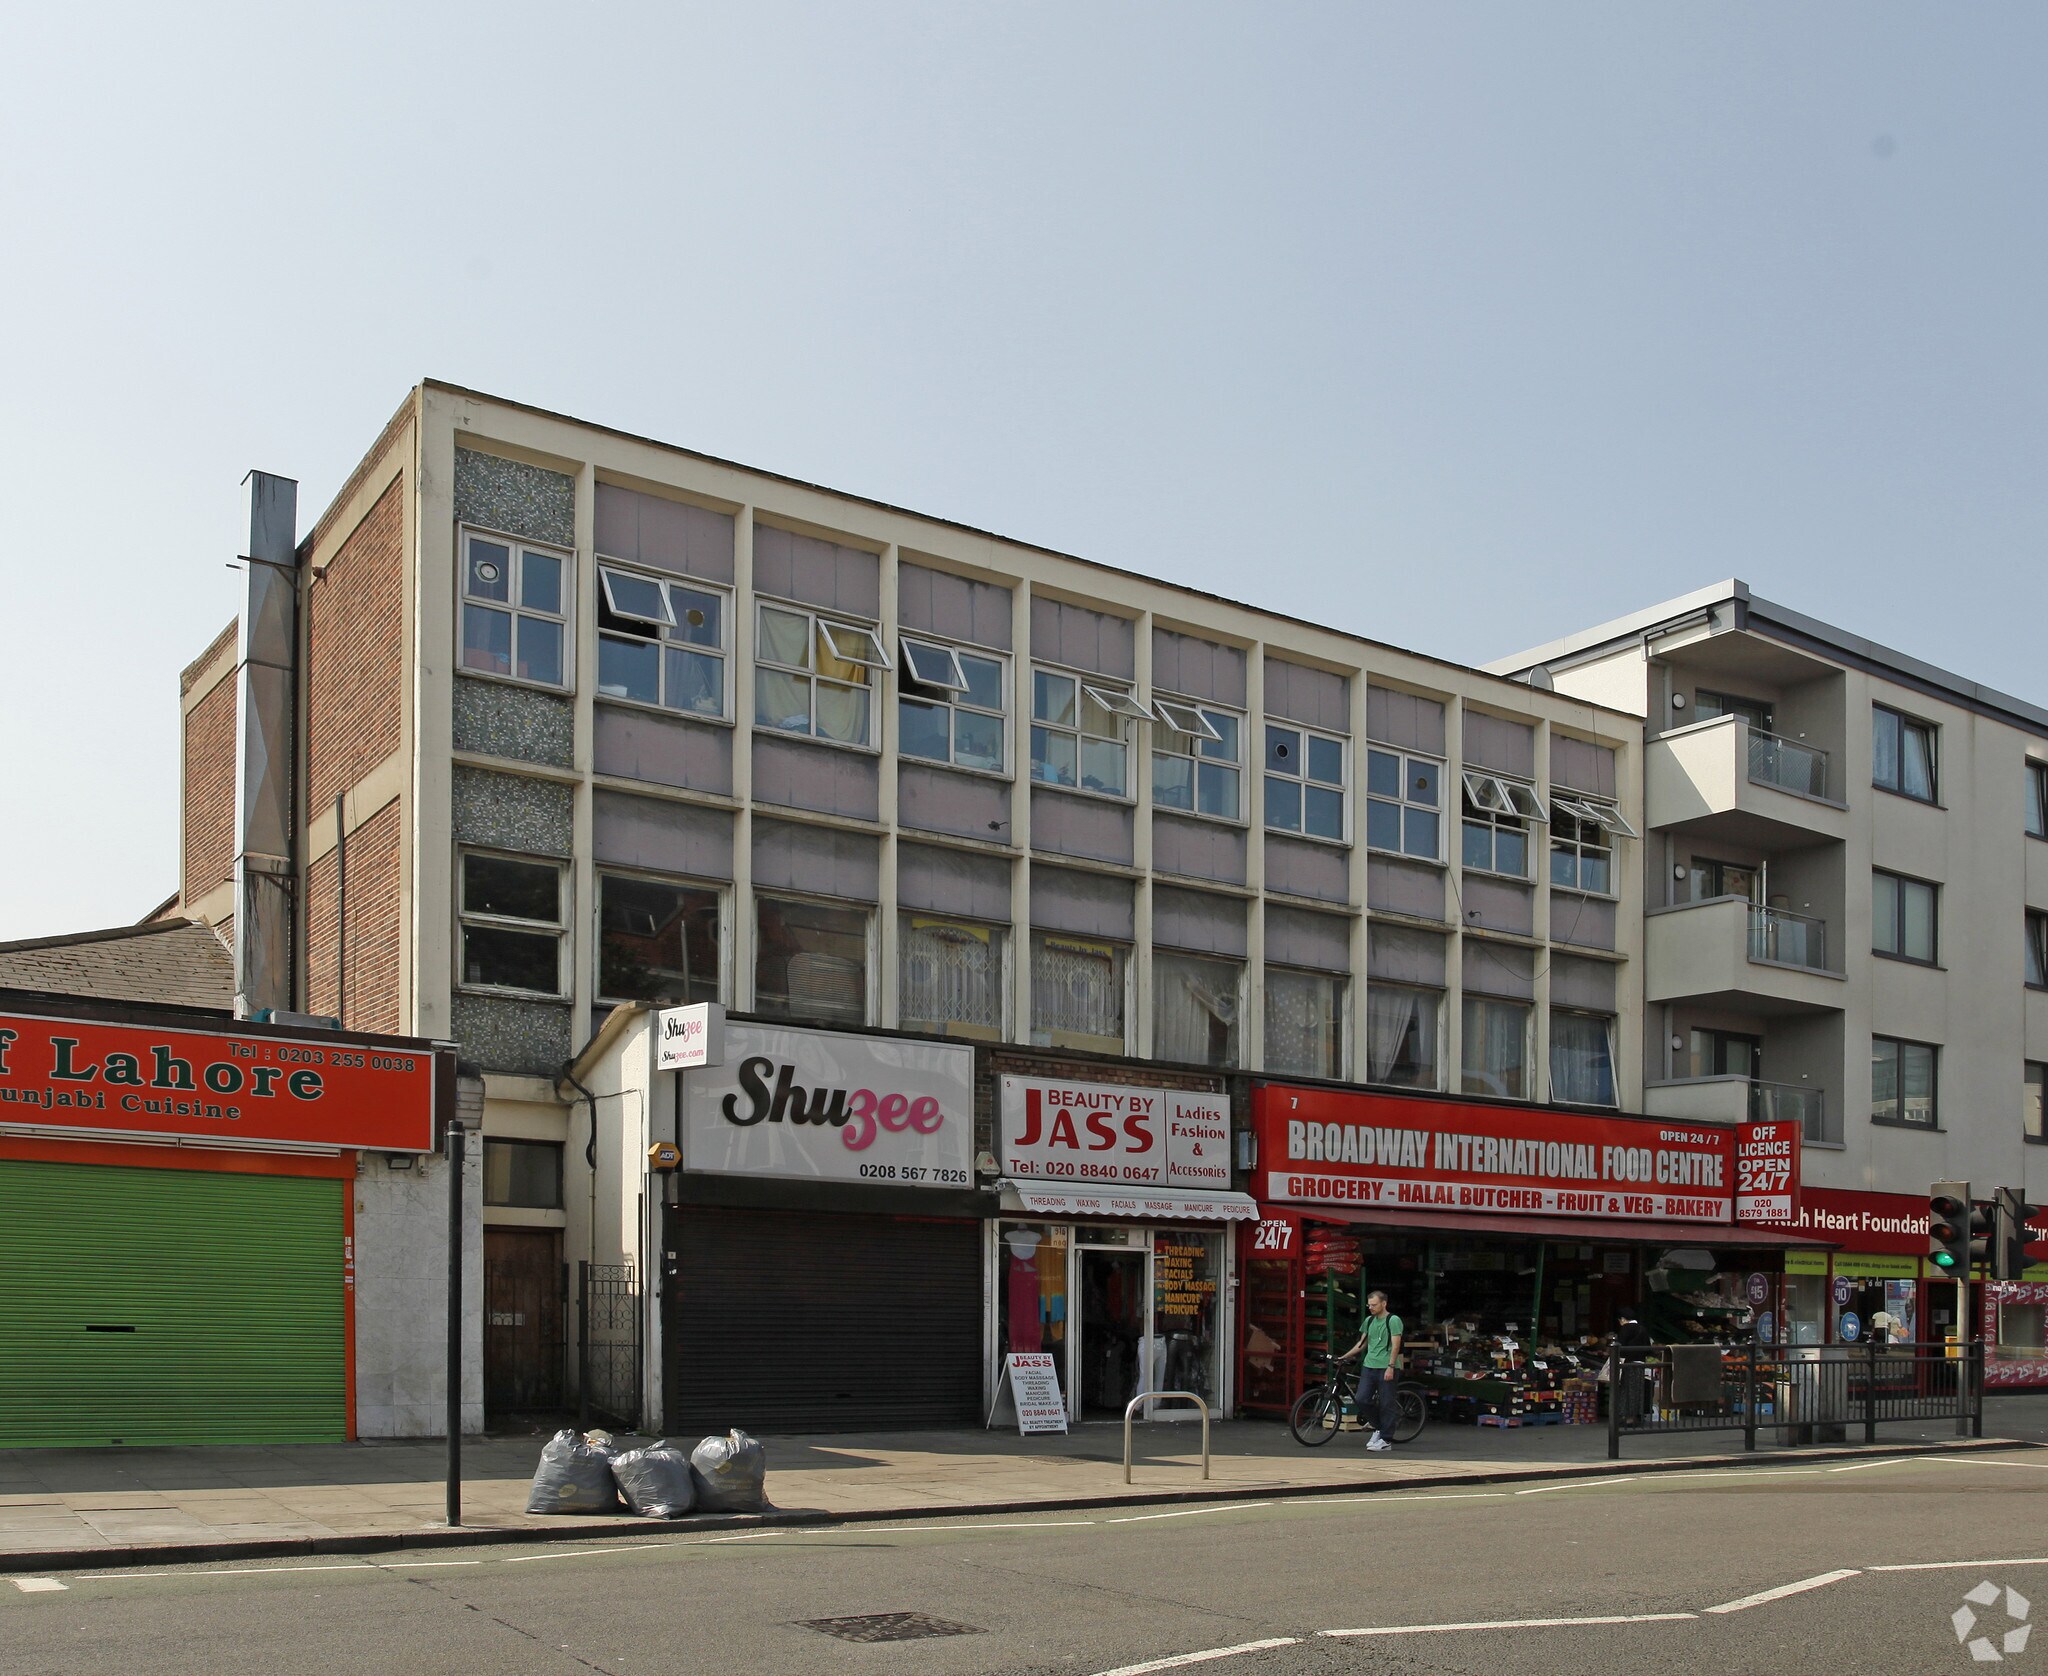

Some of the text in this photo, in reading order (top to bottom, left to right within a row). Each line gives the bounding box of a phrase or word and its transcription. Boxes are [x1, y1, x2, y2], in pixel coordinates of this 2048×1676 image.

[664, 1017, 703, 1043] Shuzee
[278, 1047, 324, 1064] 0203
[330, 1053, 365, 1068] 255
[371, 1056, 415, 1072] 0038
[661, 1049, 704, 1063] Shuzee.com
[0, 1028, 325, 1101] f Lahore
[0, 1087, 241, 1120] unjabi Cuisine
[721, 1056, 944, 1152] Shuzee
[1048, 1089, 1154, 1113] BEAUTY BY
[1290, 1097, 1298, 1110] 7
[1014, 1088, 1154, 1153] JASS
[1660, 1130, 1688, 1143] OPEN
[1752, 1126, 1777, 1141] OFF
[660, 1151, 675, 1160] ADT
[1192, 1142, 1203, 1156] &
[1288, 1120, 1724, 1187] BROADWAY INTERNATIONAL FOOD CENTRE
[1738, 1141, 1790, 1157] LICENCE
[859, 1164, 896, 1178] 0208
[901, 1167, 927, 1180] 567
[932, 1169, 967, 1182] 7826
[1009, 1159, 1159, 1181] Tel: 020 8840 0647
[1738, 1158, 1791, 1173] OPEN
[1738, 1171, 1790, 1192] 24/7
[1288, 1177, 1383, 1200] GROCERY
[1398, 1183, 1455, 1204] HALAL
[1460, 1188, 1542, 1209] BUTCHER
[1557, 1193, 1605, 1212] FRUIT
[1608, 1198, 1620, 1213] &
[1623, 1196, 1653, 1215] VEG
[1665, 1198, 1723, 1218] BAKERY
[1754, 1199, 1771, 1208] 020
[1029, 1197, 1251, 1214] THREADING WAXING FACIALS MASSAGE MANICURE PEDICURE
[1739, 1208, 1788, 1218] 8579 1881
[1814, 1208, 1858, 1231] Heart
[1862, 1211, 1929, 1235] Foundati
[1254, 1226, 1293, 1250] 24/7
[1165, 1246, 1205, 1257] THREADING
[1165, 1257, 1193, 1268] WAXING
[1165, 1269, 1194, 1279] FACIALS
[1165, 1280, 1217, 1292] BODY MASSAGE
[1165, 1293, 1201, 1304] MANICURE
[1835, 1287, 1847, 1301] £10
[1165, 1304, 1199, 1315] PEDICURE
[1012, 1355, 1052, 1367] JASS
[1022, 1409, 1033, 1417] 020
[1048, 1408, 1060, 1416] 0647
